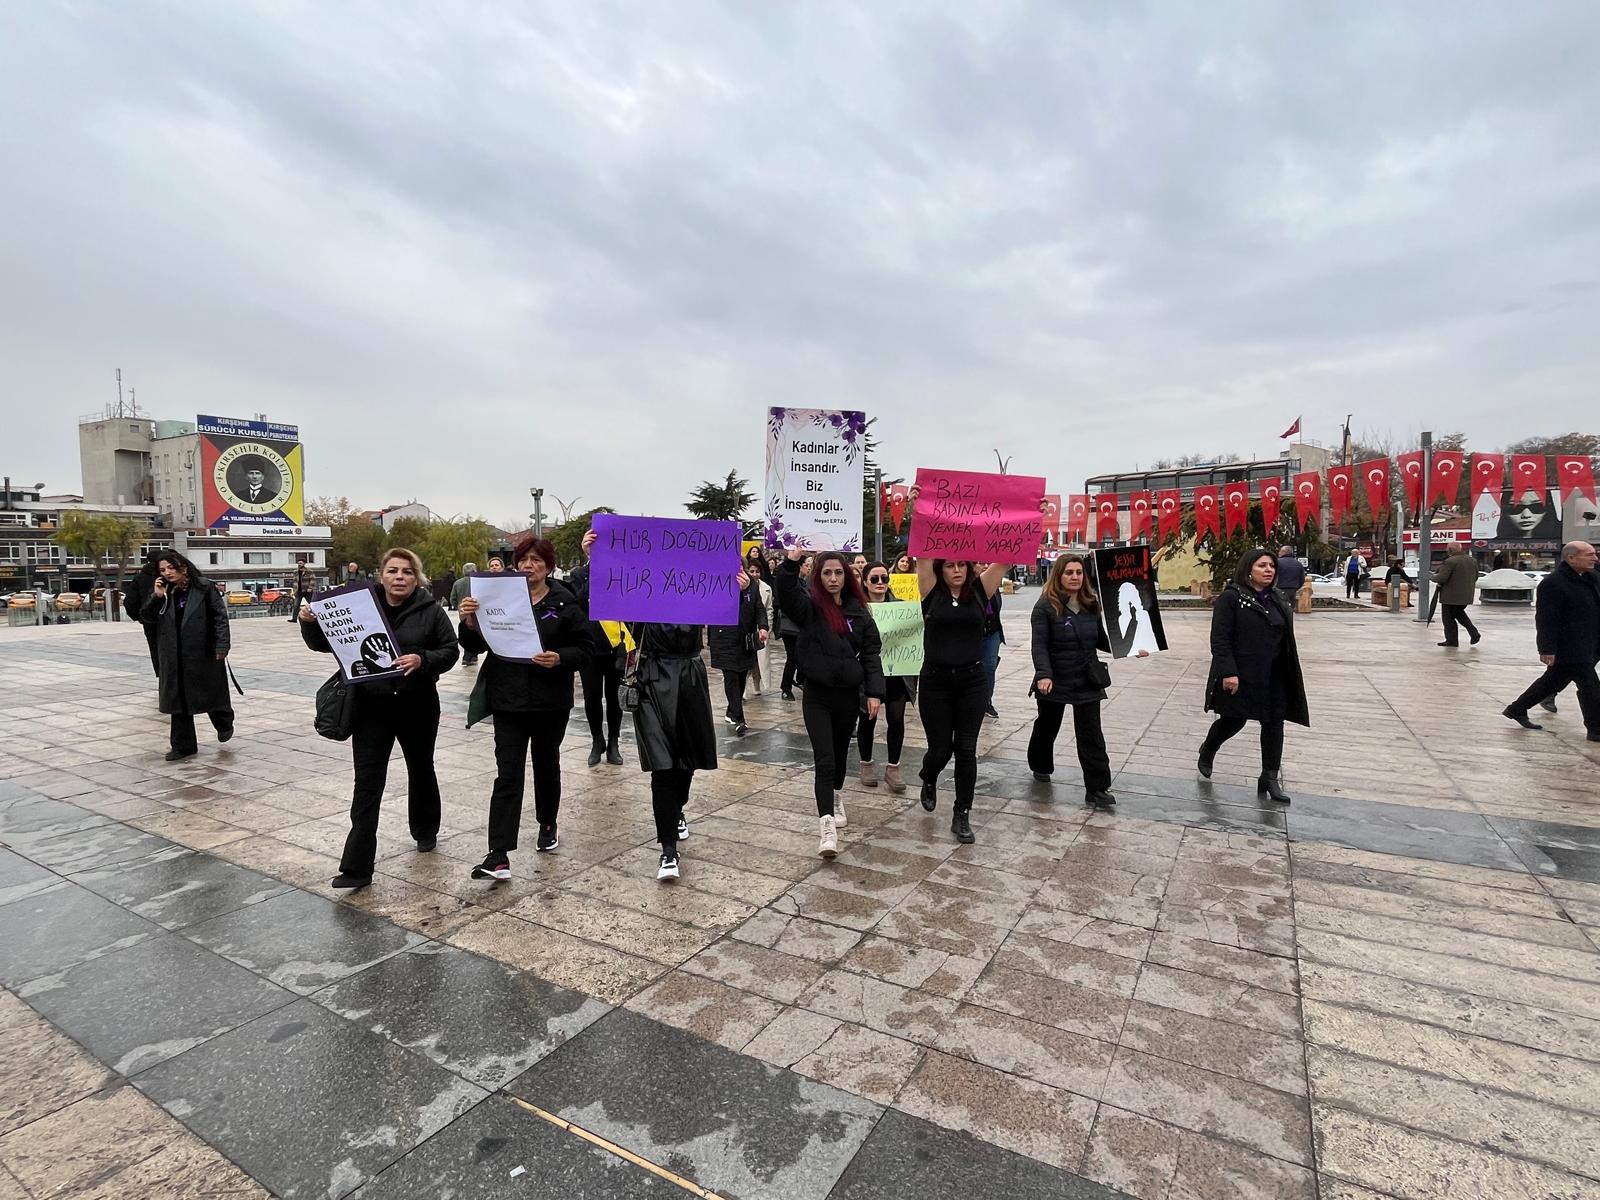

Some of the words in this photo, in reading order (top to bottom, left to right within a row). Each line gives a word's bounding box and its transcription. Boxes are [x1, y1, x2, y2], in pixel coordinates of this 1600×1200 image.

[198, 423, 236, 434] SÜRÜCÜ
[237, 428, 268, 437] KURSU
[792, 440, 839, 455] Kadınlar
[791, 457, 839, 473] İnsandır.
[806, 479, 823, 492] Biz
[785, 495, 843, 514] İnsanoğlu.
[933, 501, 1001, 520] KADINLAR
[926, 520, 973, 536] YEMEK
[984, 520, 1041, 537] YAPMAZ
[1413, 531, 1454, 539] EANE
[610, 528, 652, 553] HÜR
[662, 528, 740, 557] DOĞDUM
[606, 566, 653, 599] HÜR
[661, 567, 734, 599] YAŞARIM
[324, 601, 337, 610] BU
[485, 608, 506, 616] KADIN
[317, 607, 352, 621] ÜLKEDE
[325, 617, 354, 629] KADIN
[337, 635, 359, 645] VAR!
